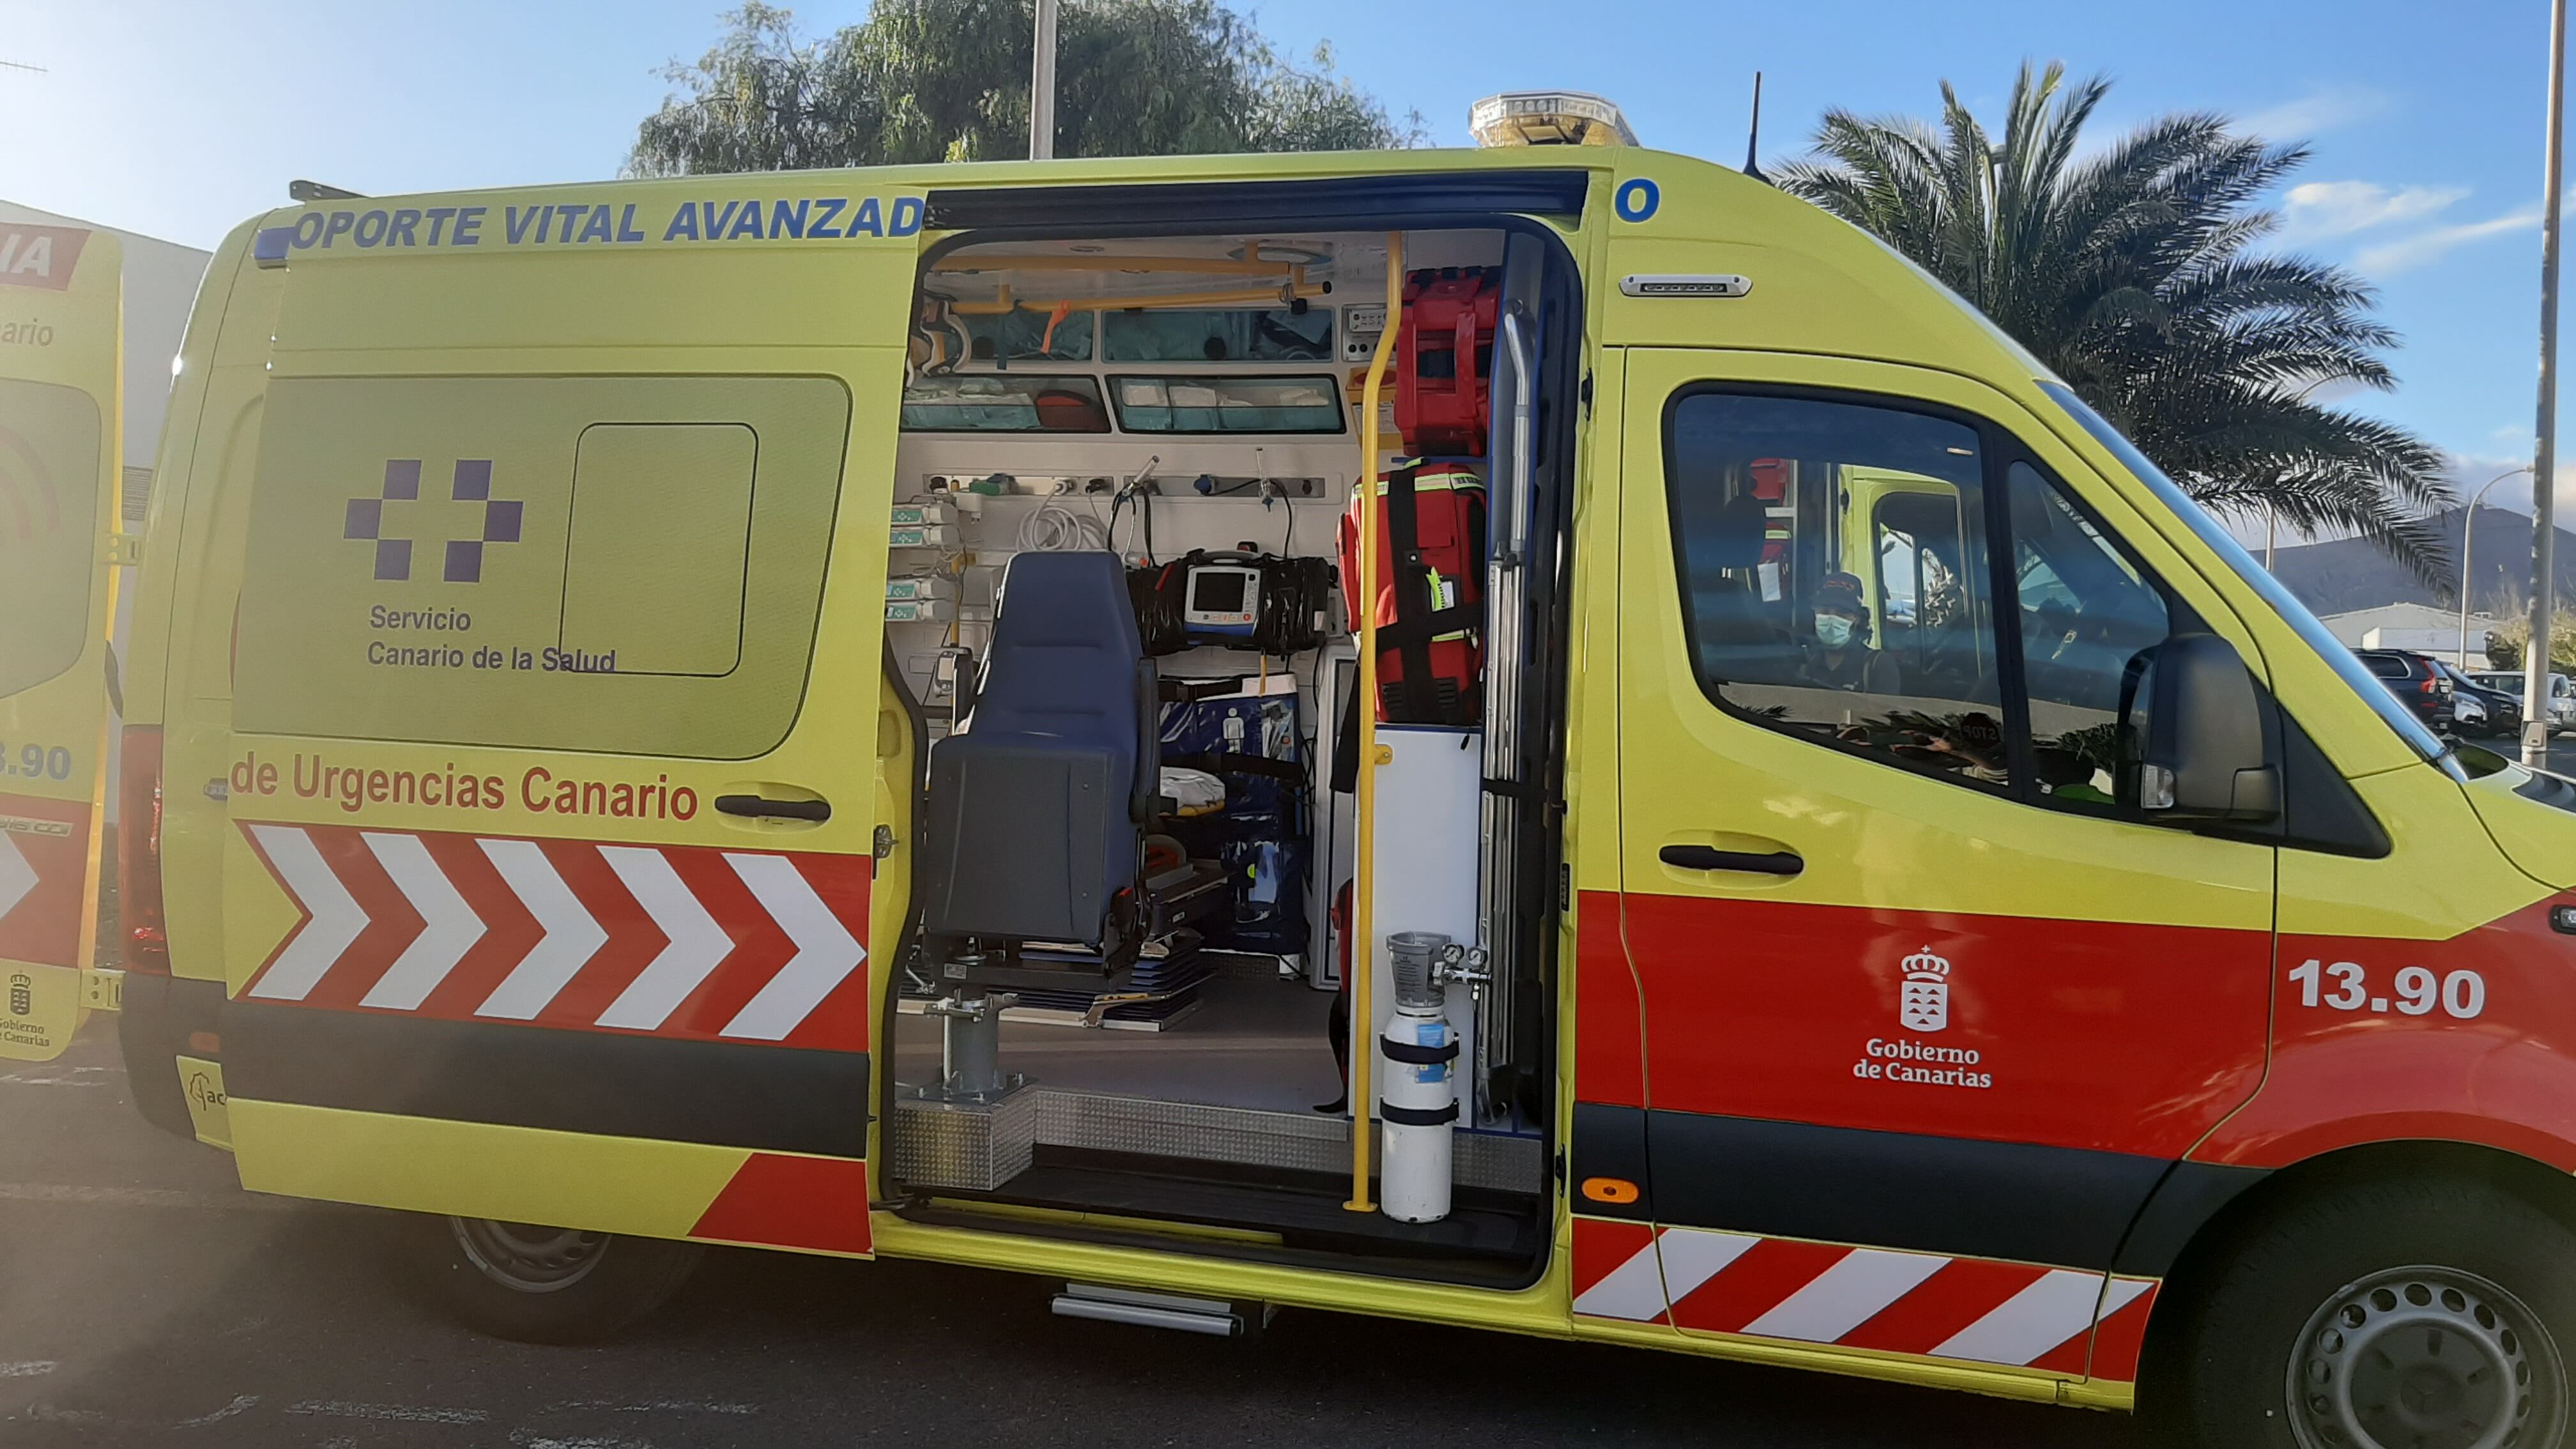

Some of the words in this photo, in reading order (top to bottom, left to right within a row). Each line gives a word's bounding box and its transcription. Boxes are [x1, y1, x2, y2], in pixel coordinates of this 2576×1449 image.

[1614, 178, 1660, 224] O
[290, 207, 487, 249] OPORTE
[505, 203, 645, 245] VITAL
[663, 197, 926, 241] AVANZAD
[0, 318, 54, 347] ario
[369, 604, 471, 631] Servicio
[367, 641, 464, 668] Canario
[472, 645, 503, 670] de
[512, 647, 533, 670] la
[542, 647, 616, 672] Salud
[0, 741, 71, 780] .90
[231, 751, 278, 795] de
[294, 753, 505, 812] Urgencias
[521, 766, 698, 821] Canario
[2288, 959, 2485, 1019] 13.90
[0, 1018, 45, 1034] obierno
[4, 1031, 50, 1047] Canarias
[1866, 1038, 1980, 1065] Gobierno
[1853, 1059, 1881, 1079] de
[1885, 1062, 1992, 1089] Canarias
[206, 1090, 227, 1106] ac
